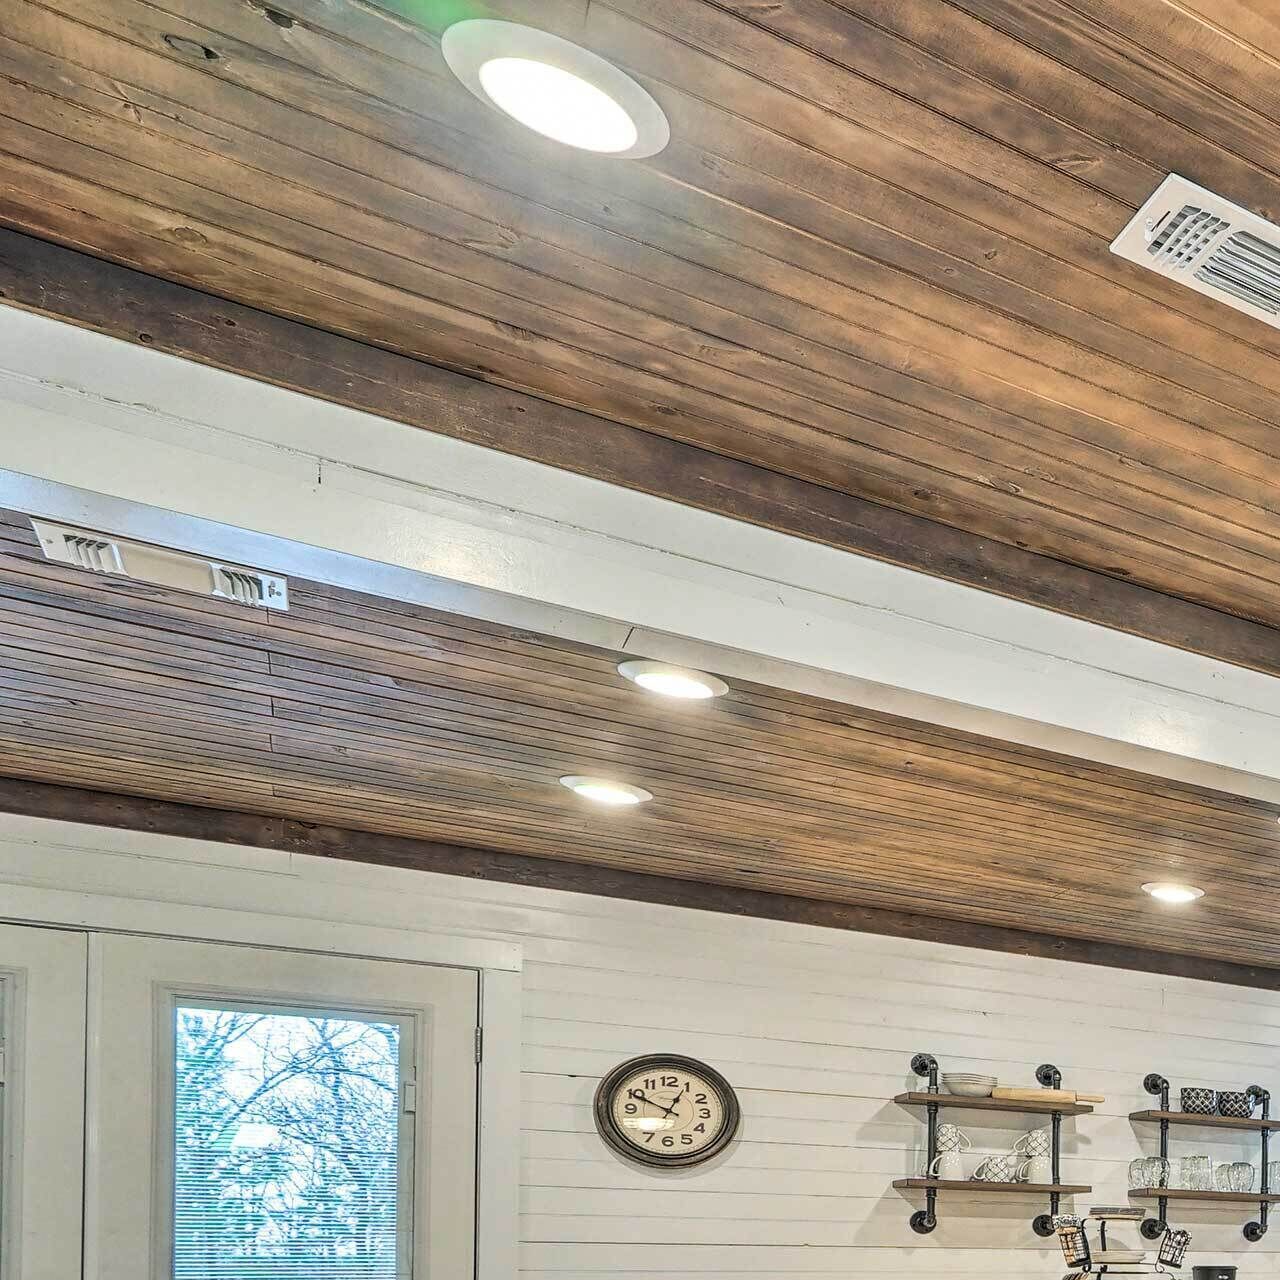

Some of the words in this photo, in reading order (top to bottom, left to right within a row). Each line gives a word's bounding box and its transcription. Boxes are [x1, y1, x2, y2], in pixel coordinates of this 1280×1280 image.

[643, 1078, 656, 1090] 11
[660, 1076, 679, 1088] 12
[684, 1082, 690, 1093] 1
[626, 1088, 645, 1100] 10
[695, 1093, 708, 1105] 2
[624, 1103, 637, 1114] 9
[698, 1108, 711, 1119] 3
[693, 1122, 706, 1134] 4
[642, 1131, 655, 1143] 7
[661, 1136, 674, 1147] 6
[680, 1134, 693, 1145] 5
